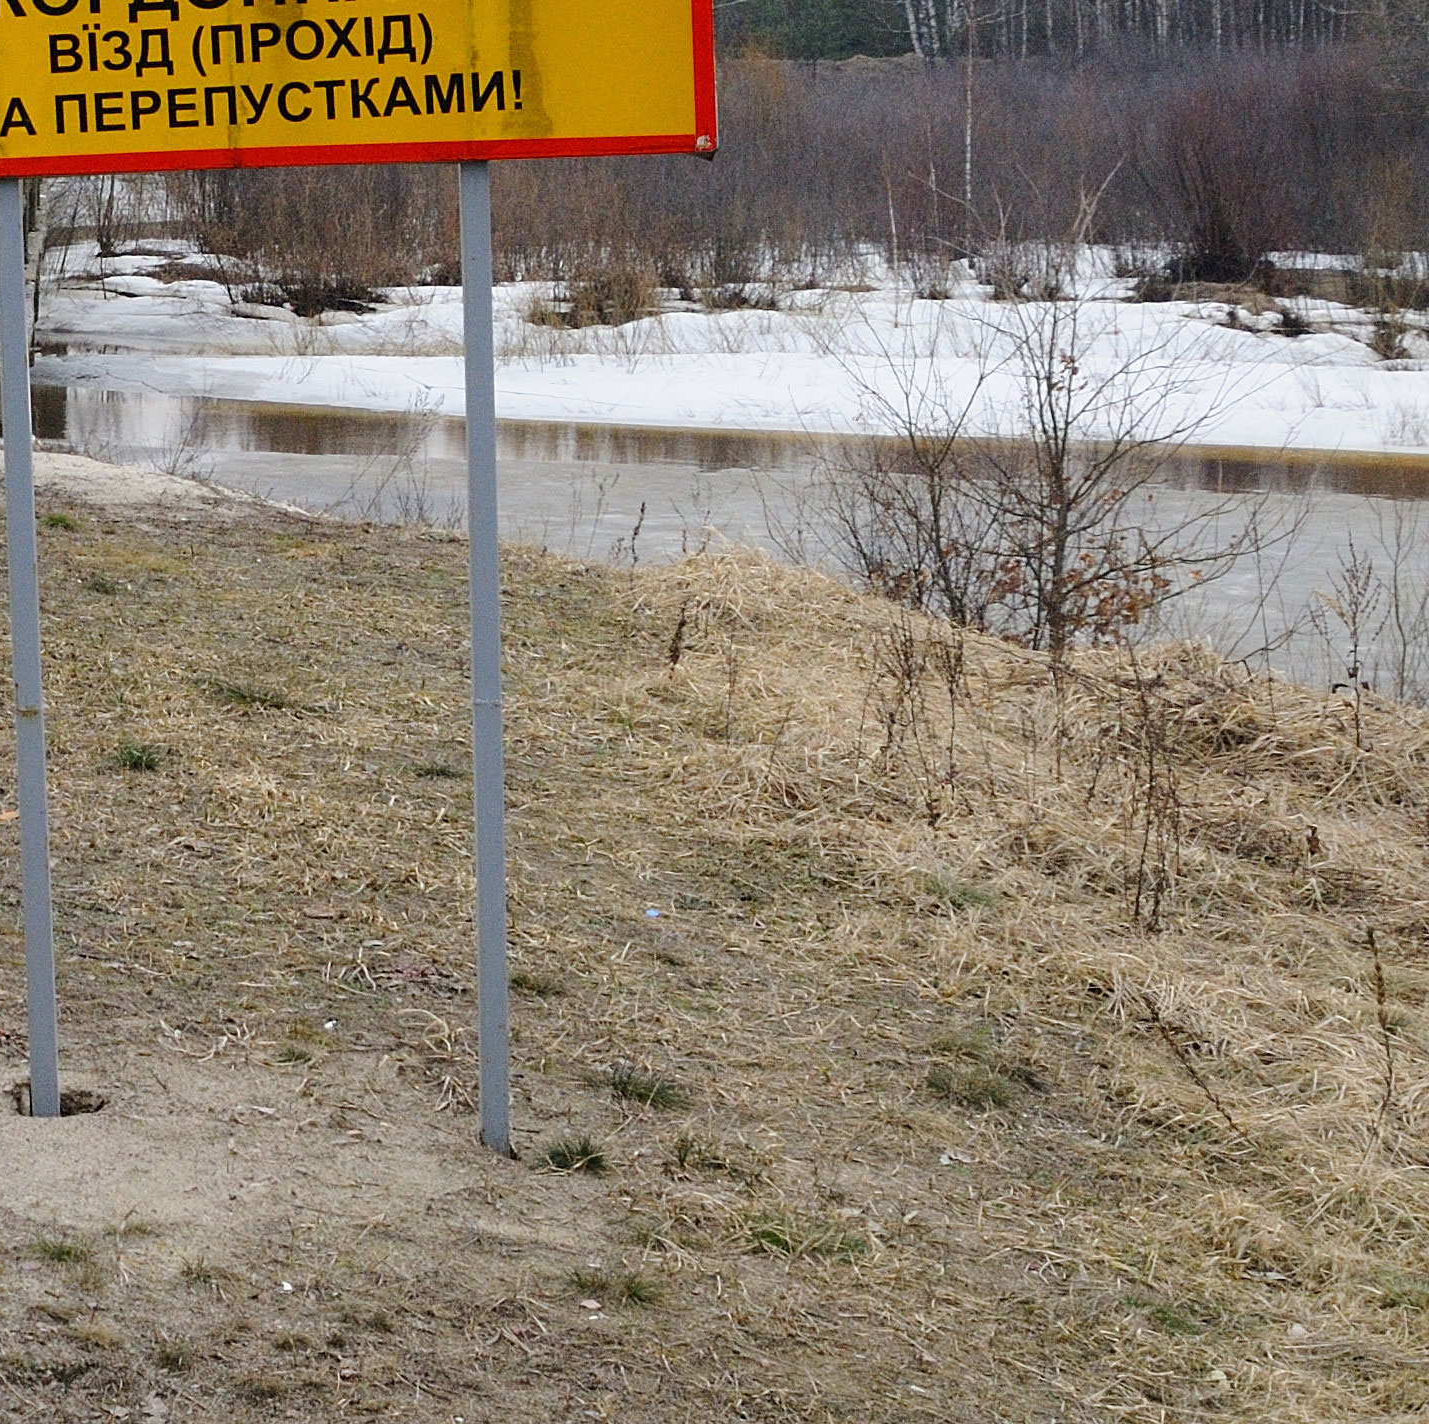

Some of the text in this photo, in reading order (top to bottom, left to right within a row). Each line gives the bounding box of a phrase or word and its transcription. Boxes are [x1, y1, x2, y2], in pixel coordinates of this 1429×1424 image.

[48, 12, 433, 78] ВЇЗД (ПРОХІД)
[54, 69, 523, 135] ПЕРЕПУСТКАМИ!
